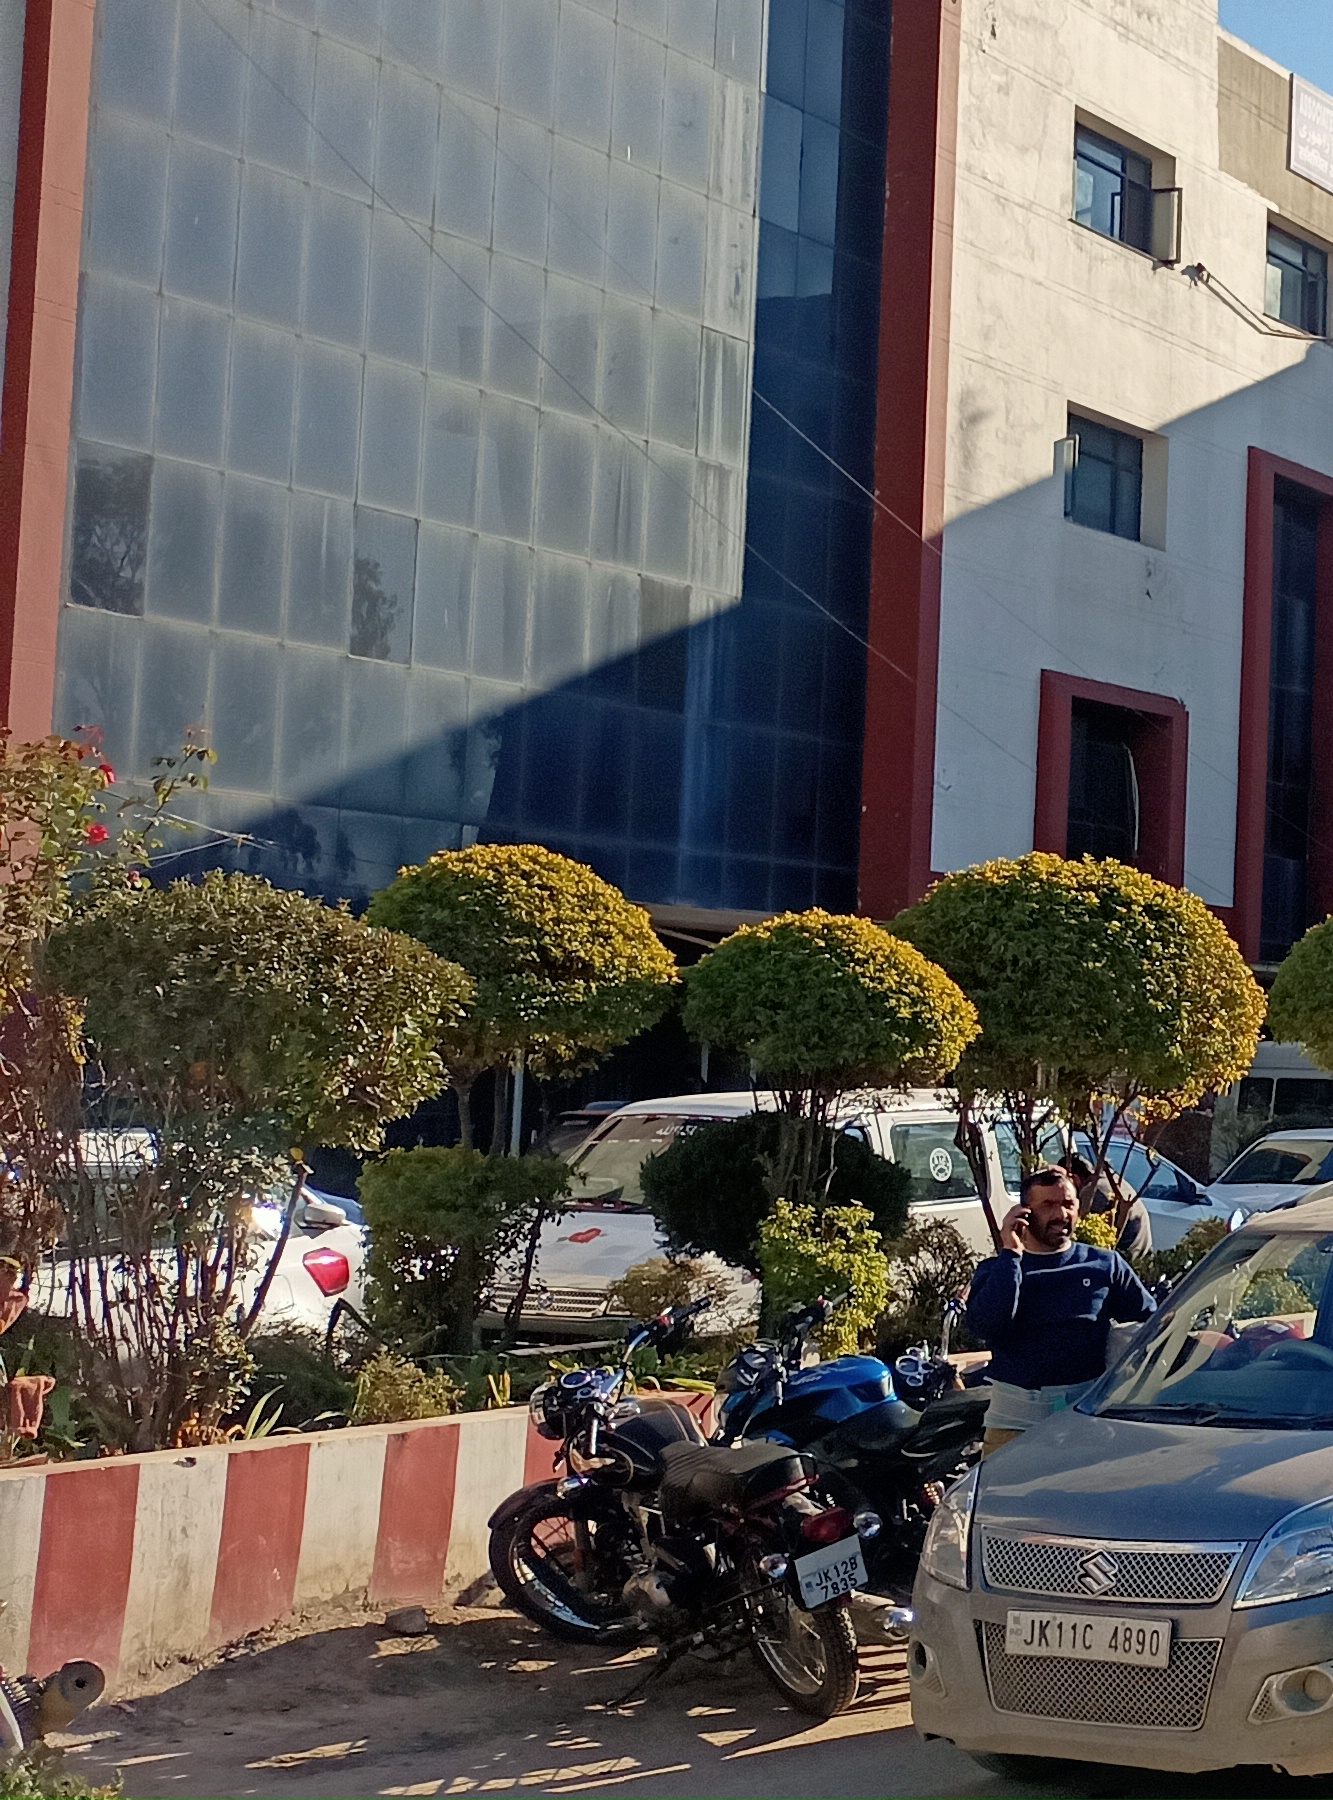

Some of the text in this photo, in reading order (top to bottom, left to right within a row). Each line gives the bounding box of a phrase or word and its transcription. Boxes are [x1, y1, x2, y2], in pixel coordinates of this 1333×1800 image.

[820, 1572, 858, 1599] 7835
[1023, 1619, 1160, 1657] JK11C 4890
